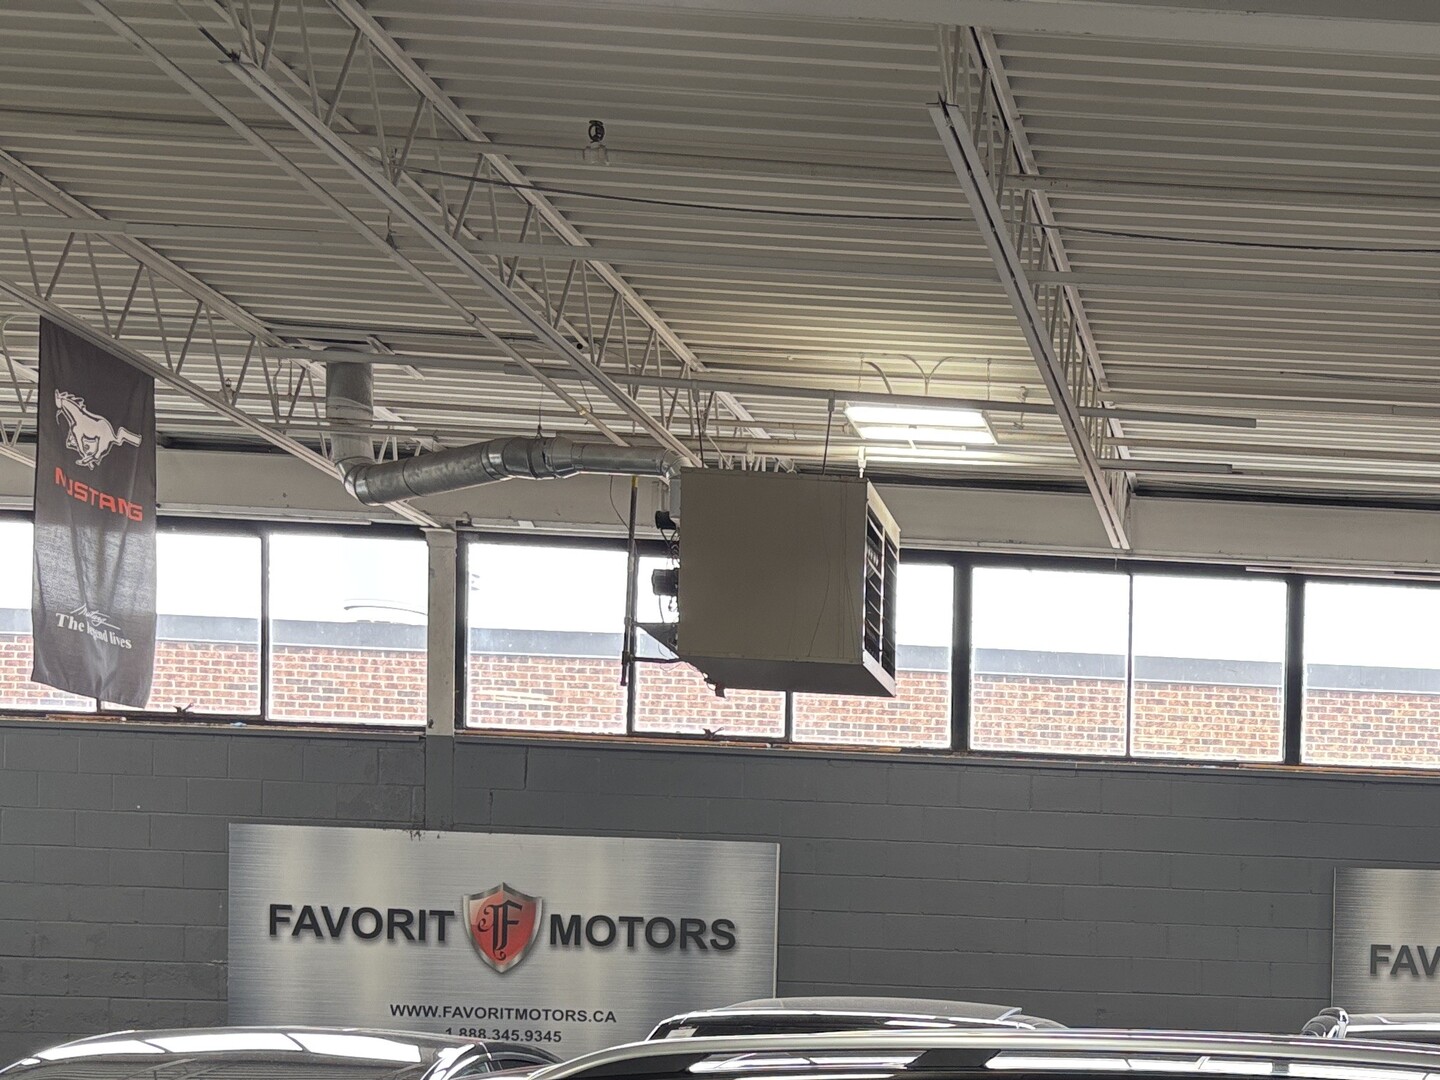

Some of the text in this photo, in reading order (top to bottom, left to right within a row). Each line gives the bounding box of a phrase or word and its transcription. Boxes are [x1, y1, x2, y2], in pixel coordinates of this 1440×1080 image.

[55, 612, 85, 632] The
[109, 631, 132, 649] lives
[268, 904, 455, 942] FAVORIT
[549, 914, 737, 951] MOTORS
[390, 1004, 617, 1023] WWW.FAVORITMOTORS.CA
[445, 1027, 562, 1042] 1888.345.9345
